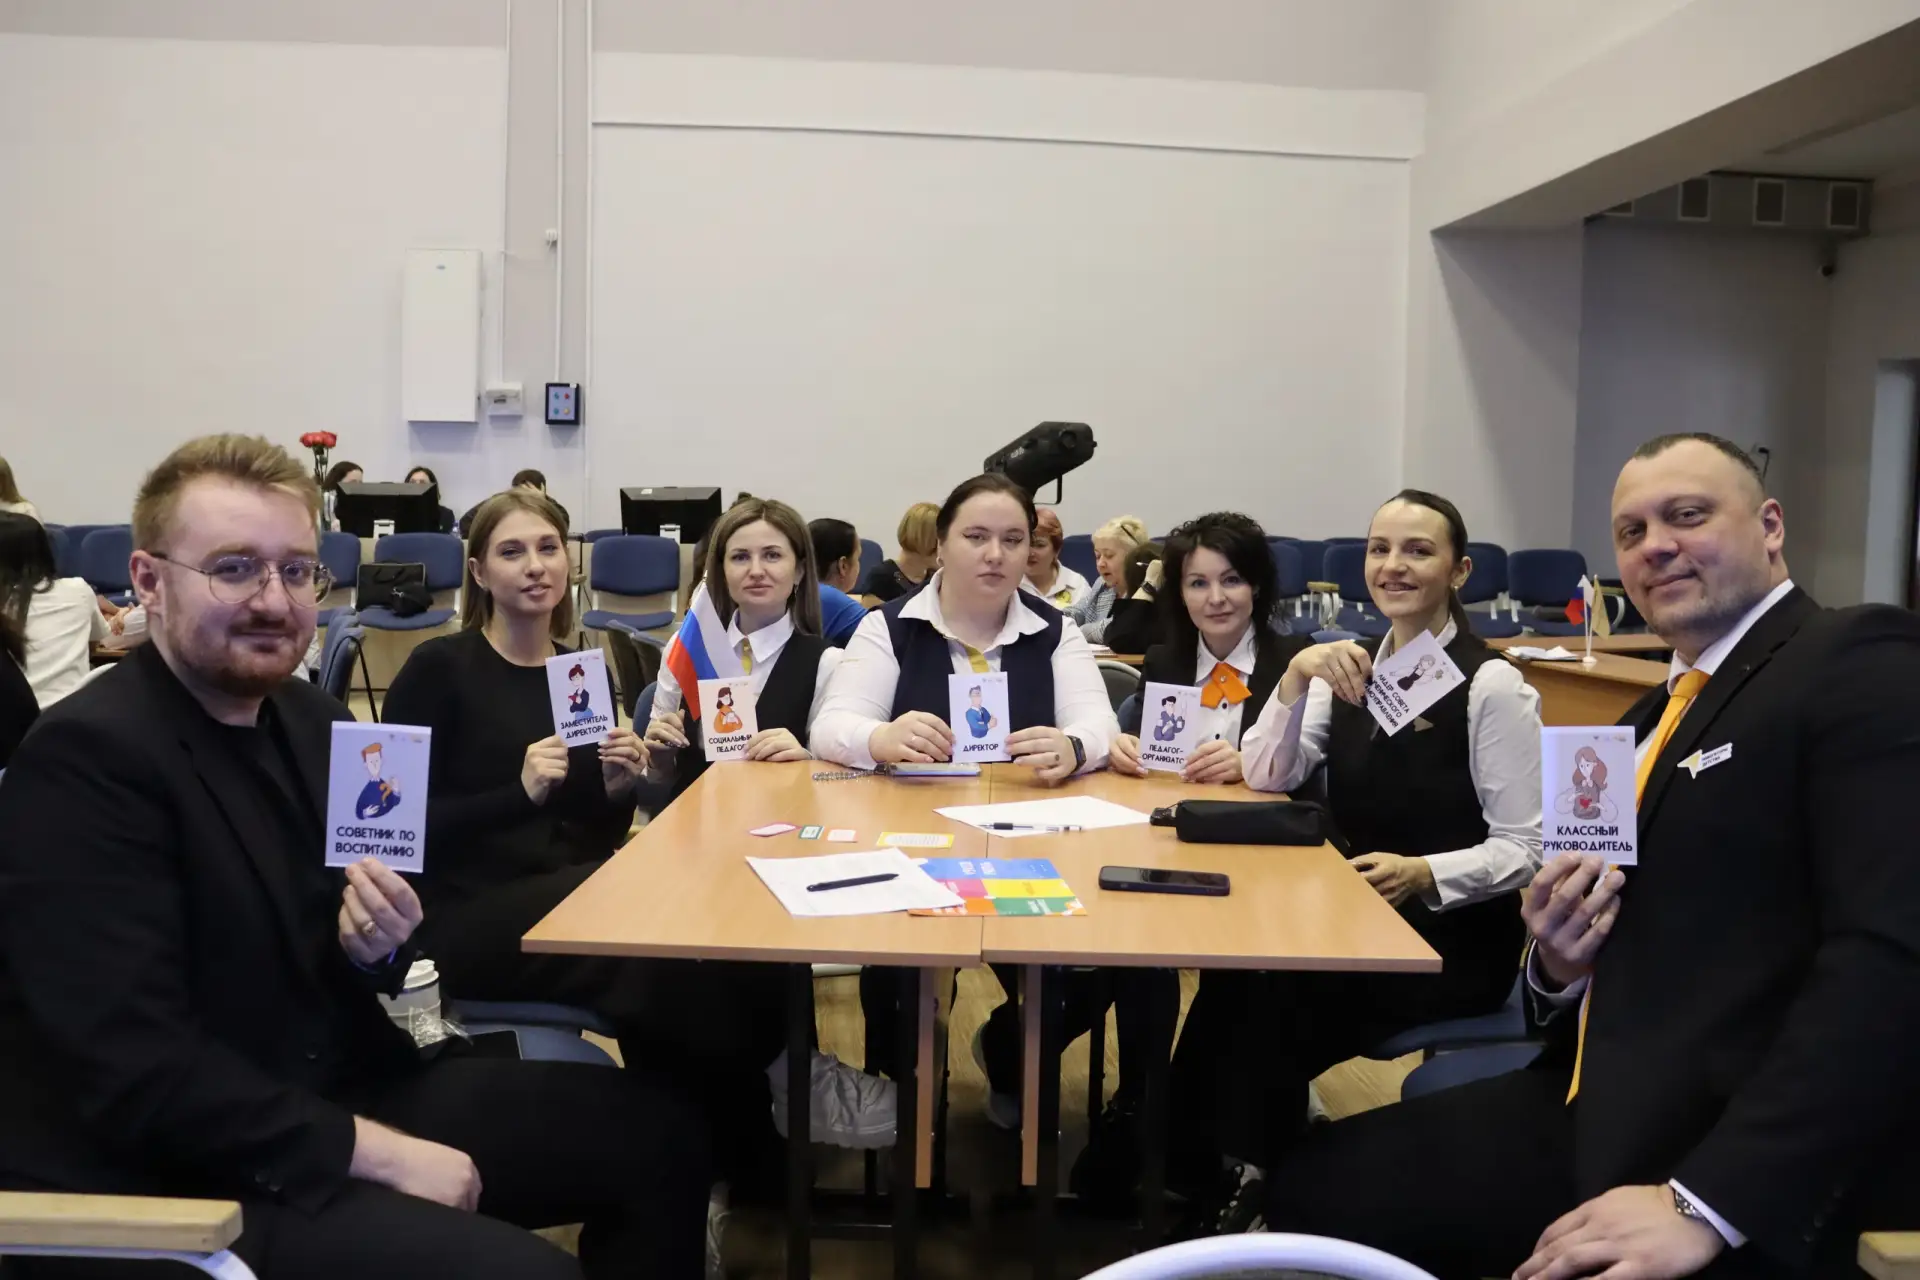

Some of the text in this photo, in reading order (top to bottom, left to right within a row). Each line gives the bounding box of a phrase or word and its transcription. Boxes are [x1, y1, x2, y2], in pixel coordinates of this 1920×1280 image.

[1377, 674, 1410, 714] ЛИДЕР СОВЕТА
[1365, 685, 1399, 728] АМОУПРАВЛЕНИЯ
[560, 714, 608, 730] ЗАМЕСТИТЕЛЬ
[565, 725, 608, 739] ДИРЕКТОРА
[963, 743, 999, 752] ДИРЕКТОР
[1149, 744, 1184, 754] ПЕДАГОГ-
[1142, 753, 1185, 764] ОРГАНИЗАТО
[336, 826, 416, 842] СОВЕТНИК ПО
[1557, 825, 1619, 836] КЛАССНЫЙ
[335, 842, 415, 858] ВОСПИТАНИЮ
[1543, 840, 1633, 852] РУКОВОДИТЕЛЬ
